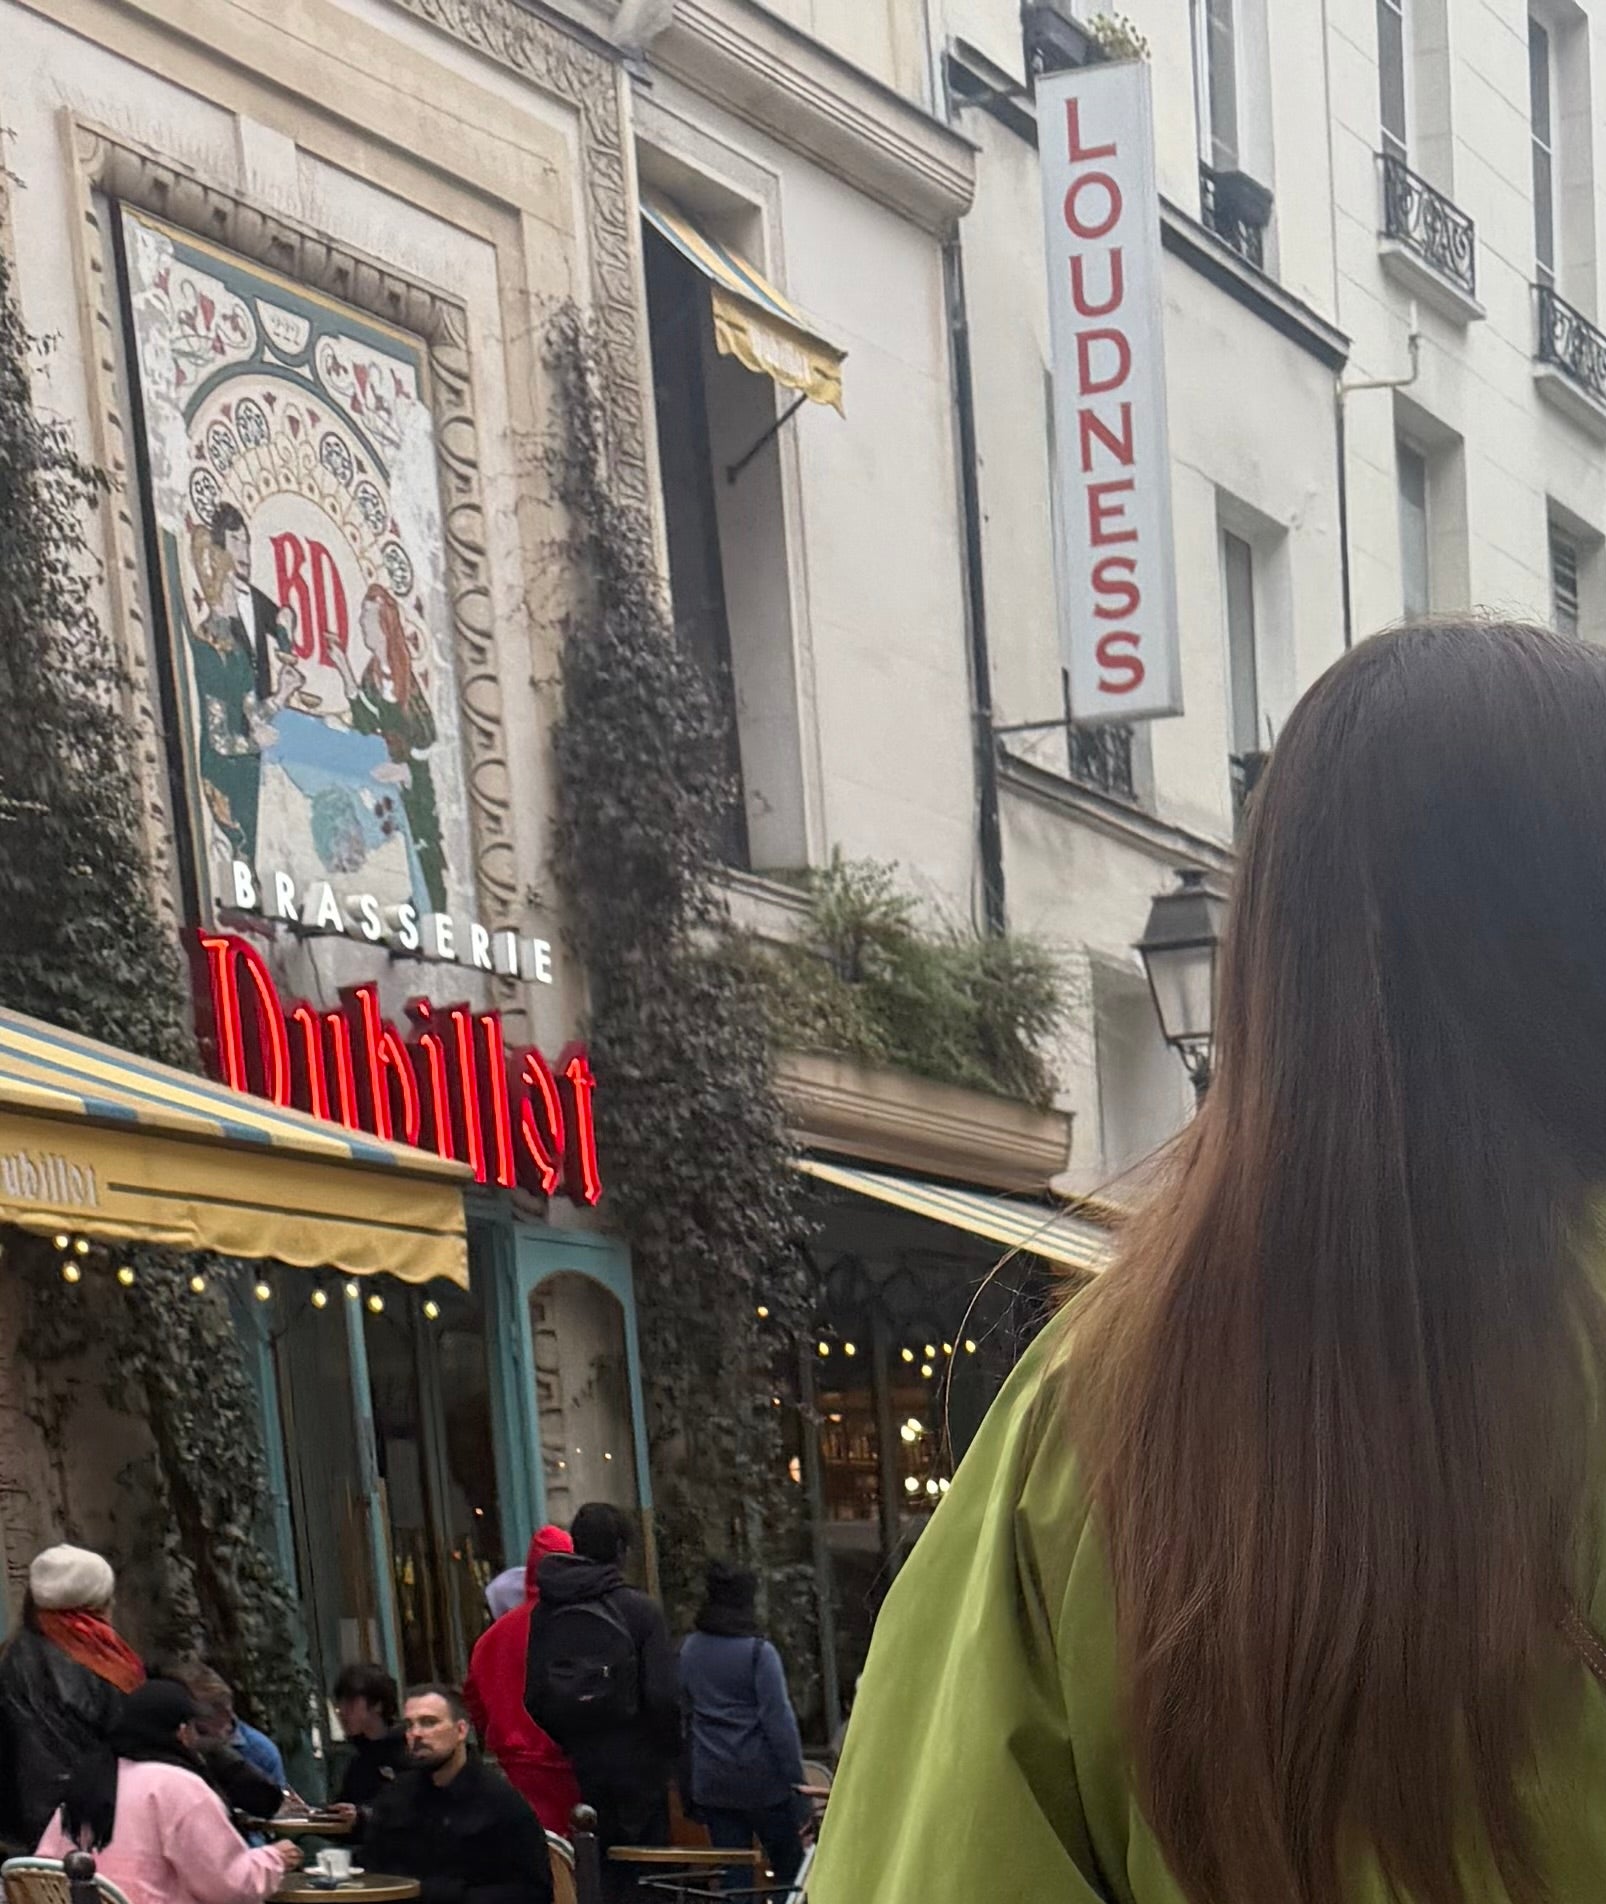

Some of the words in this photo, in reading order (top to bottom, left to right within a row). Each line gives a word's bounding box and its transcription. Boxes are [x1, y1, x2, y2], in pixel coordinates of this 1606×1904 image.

[1064, 97, 1145, 695] LOUDNESS
[231, 859, 554, 984] BRASSERIE
[198, 930, 602, 1206] Dubillot
[0, 1150, 98, 1208] ubillot
